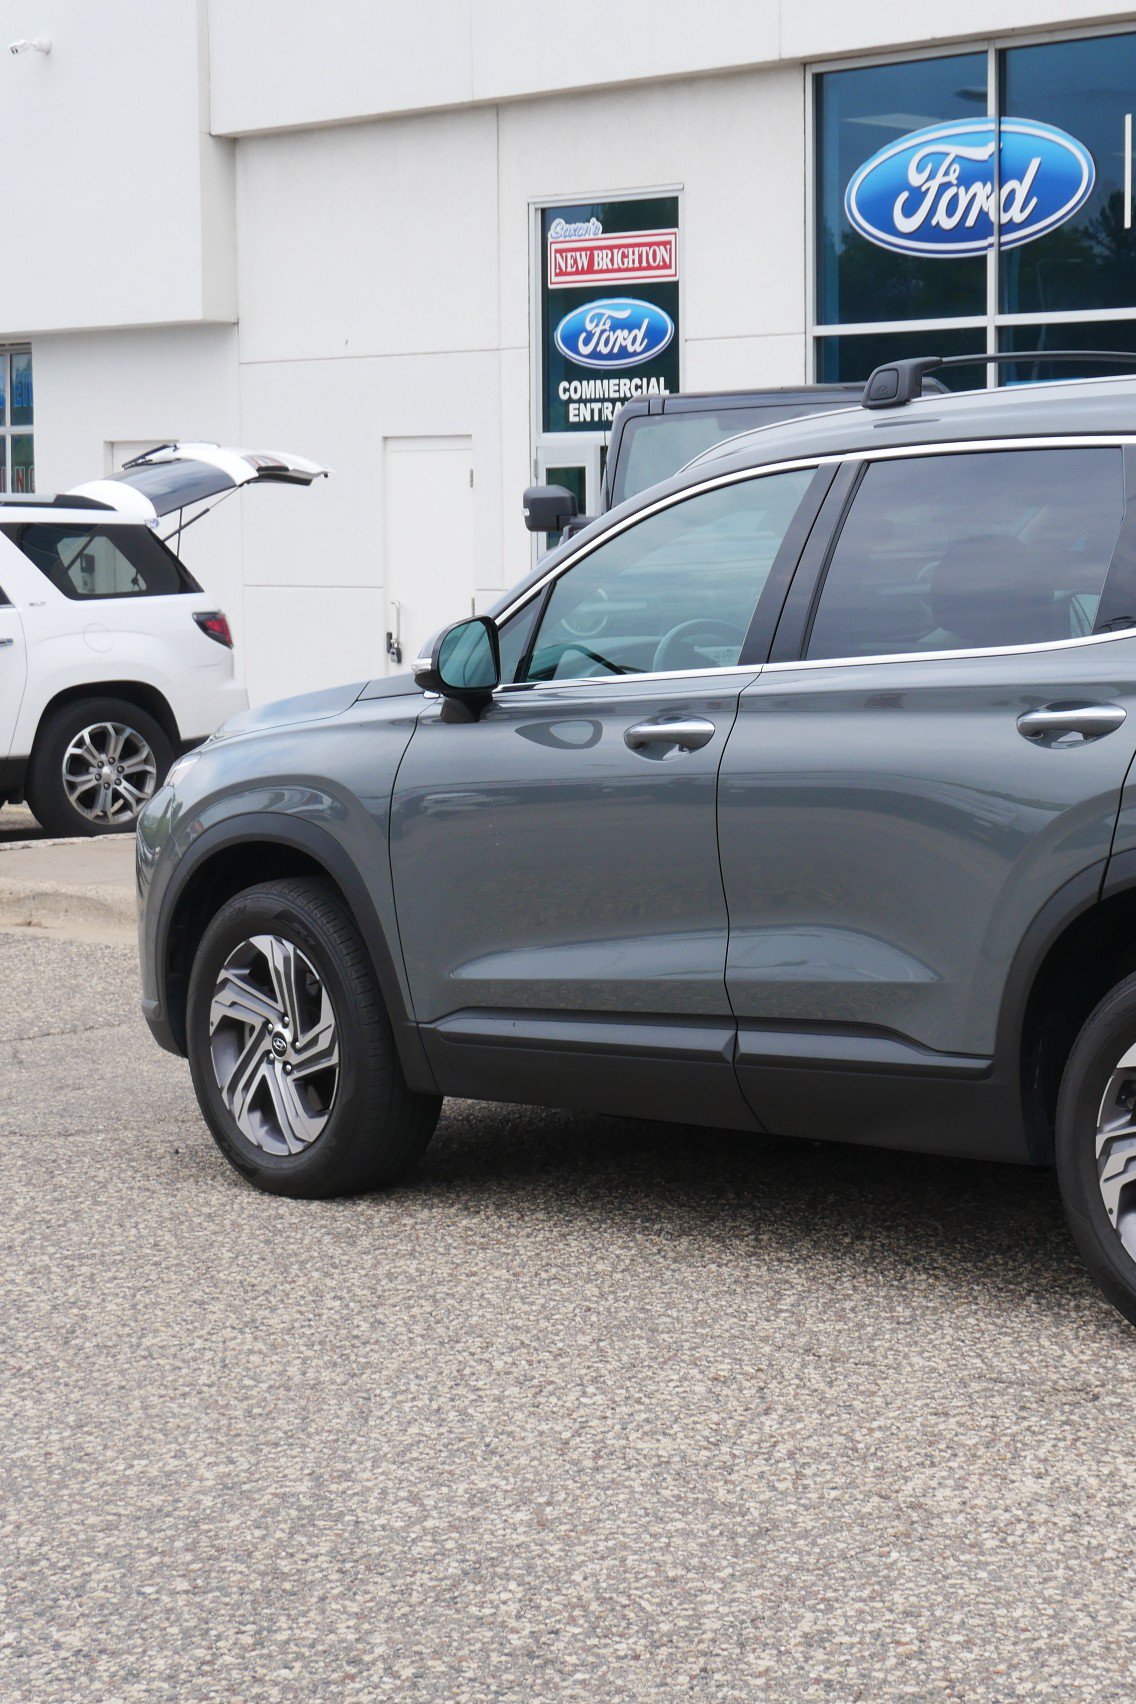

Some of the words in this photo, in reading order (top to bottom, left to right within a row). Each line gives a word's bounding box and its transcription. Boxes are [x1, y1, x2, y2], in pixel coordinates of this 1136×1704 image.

[893, 140, 1042, 234] Ford
[550, 219, 601, 240] Saxon's
[555, 250, 590, 274] NEW
[593, 244, 671, 271] BRIGHTON
[578, 308, 650, 356] Ford
[558, 376, 670, 401] COMMERCIAL
[569, 401, 627, 423] ENTRA
